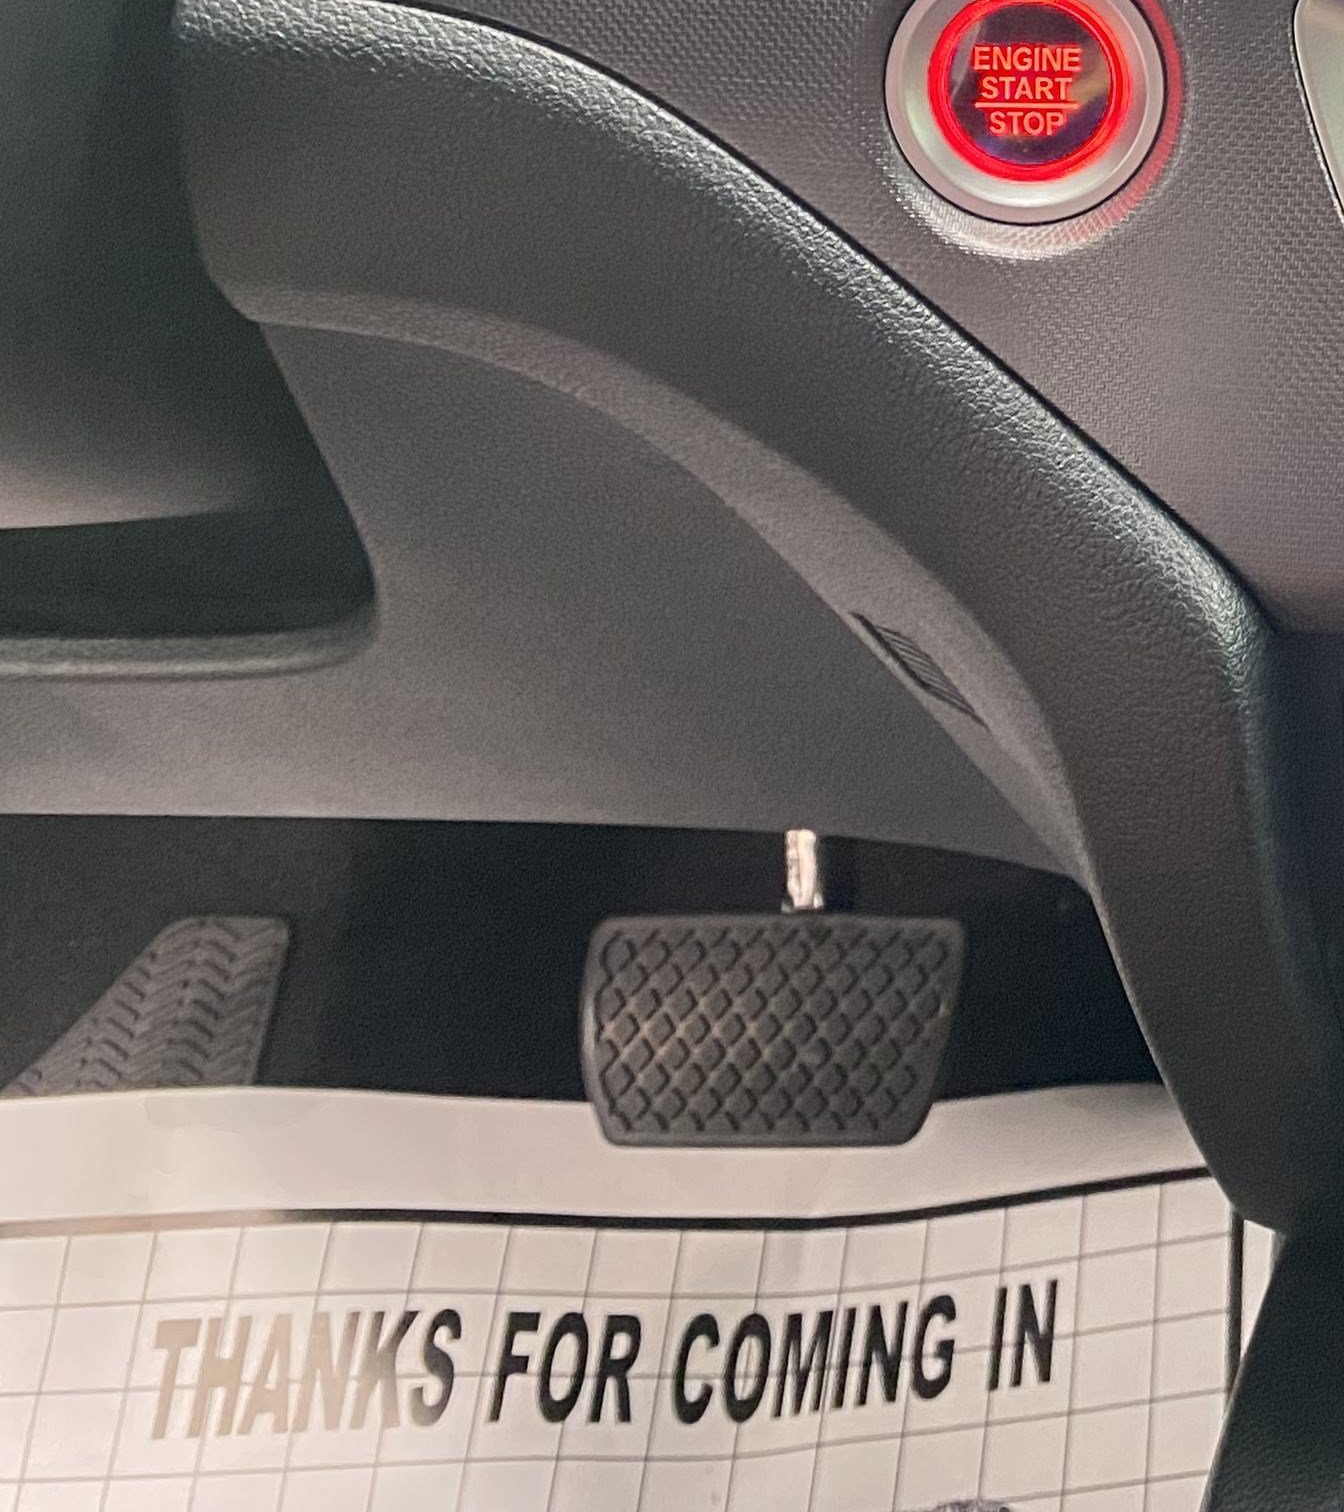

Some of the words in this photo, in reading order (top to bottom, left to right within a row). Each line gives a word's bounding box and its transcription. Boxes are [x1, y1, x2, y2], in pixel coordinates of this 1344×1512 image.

[973, 45, 1082, 72] ENGINE
[980, 76, 1073, 100] START
[989, 111, 1064, 136] STOP
[150, 1308, 463, 1441] THANKS
[484, 1310, 641, 1425] FOR
[670, 1292, 961, 1425] COMING
[985, 1279, 1061, 1394] IN
